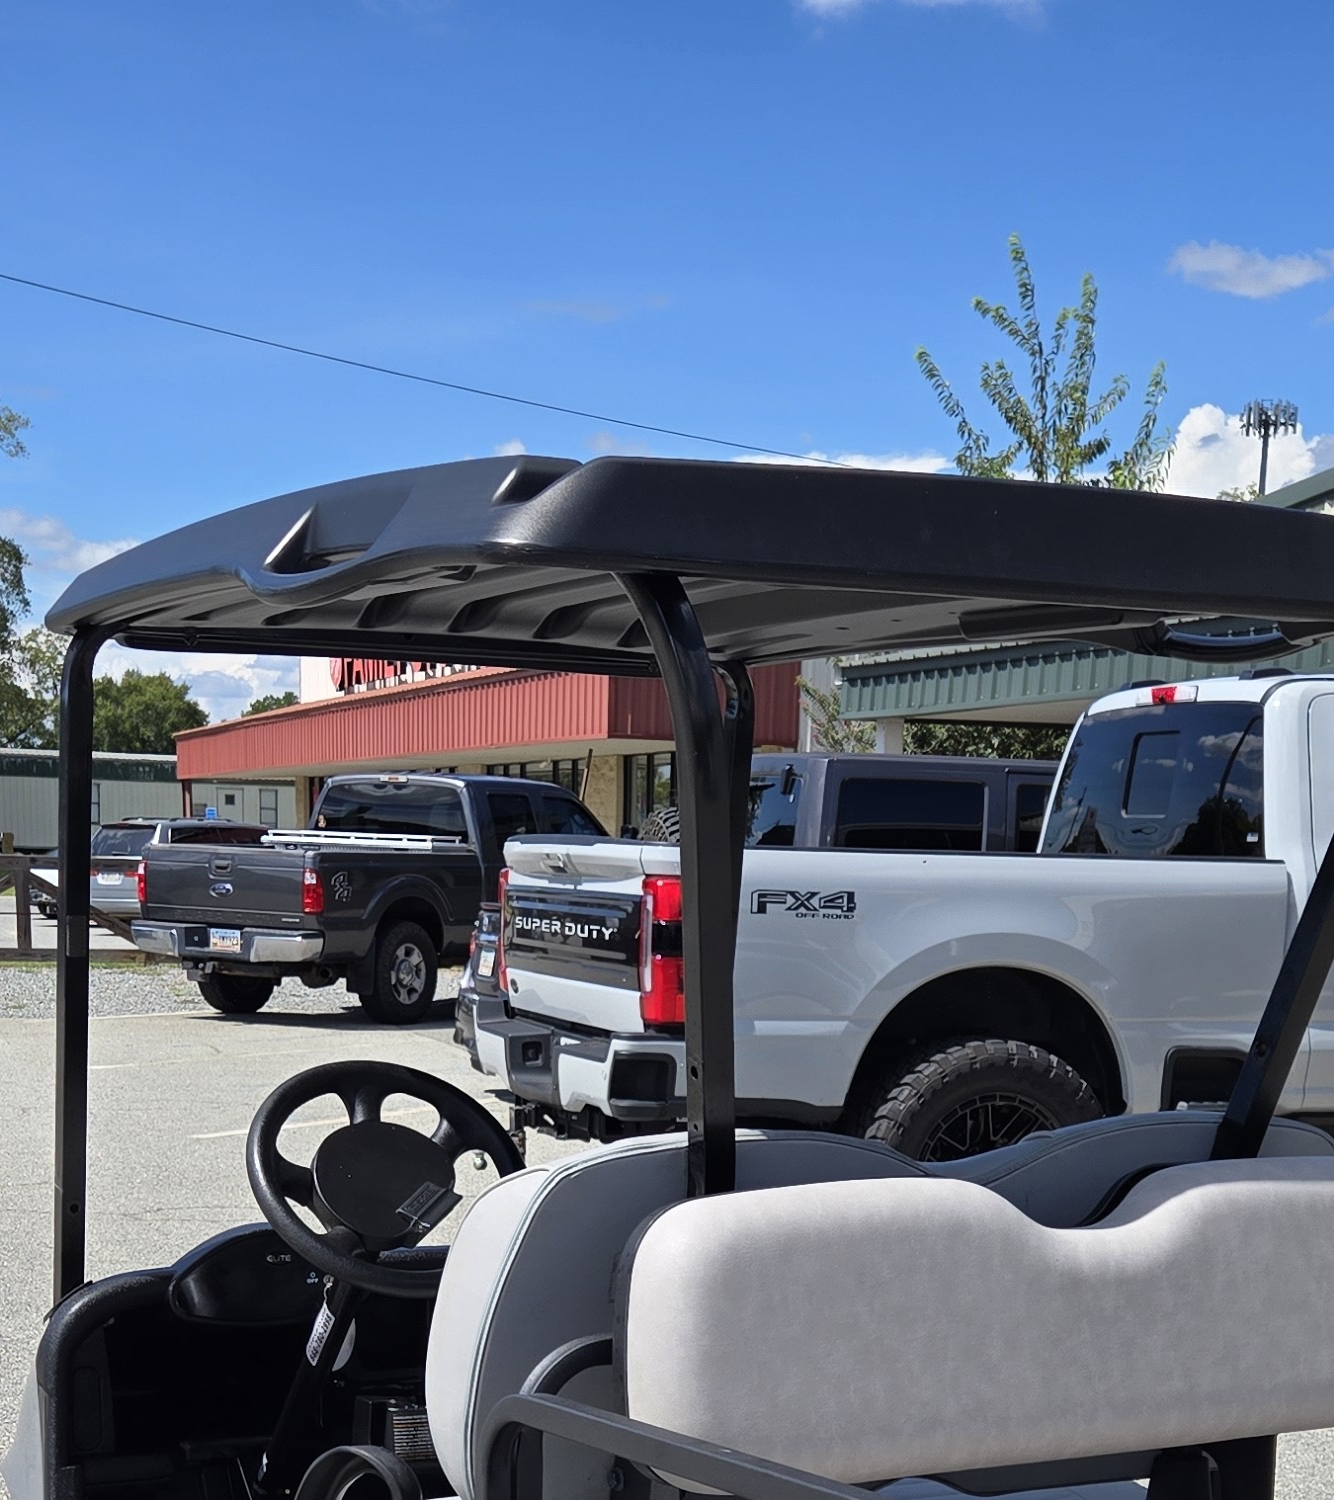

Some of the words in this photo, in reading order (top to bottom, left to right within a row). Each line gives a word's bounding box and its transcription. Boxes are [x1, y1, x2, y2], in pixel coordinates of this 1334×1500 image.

[750, 889, 857, 914] FX4
[515, 916, 562, 934] SUPER
[564, 922, 614, 941] DUTY
